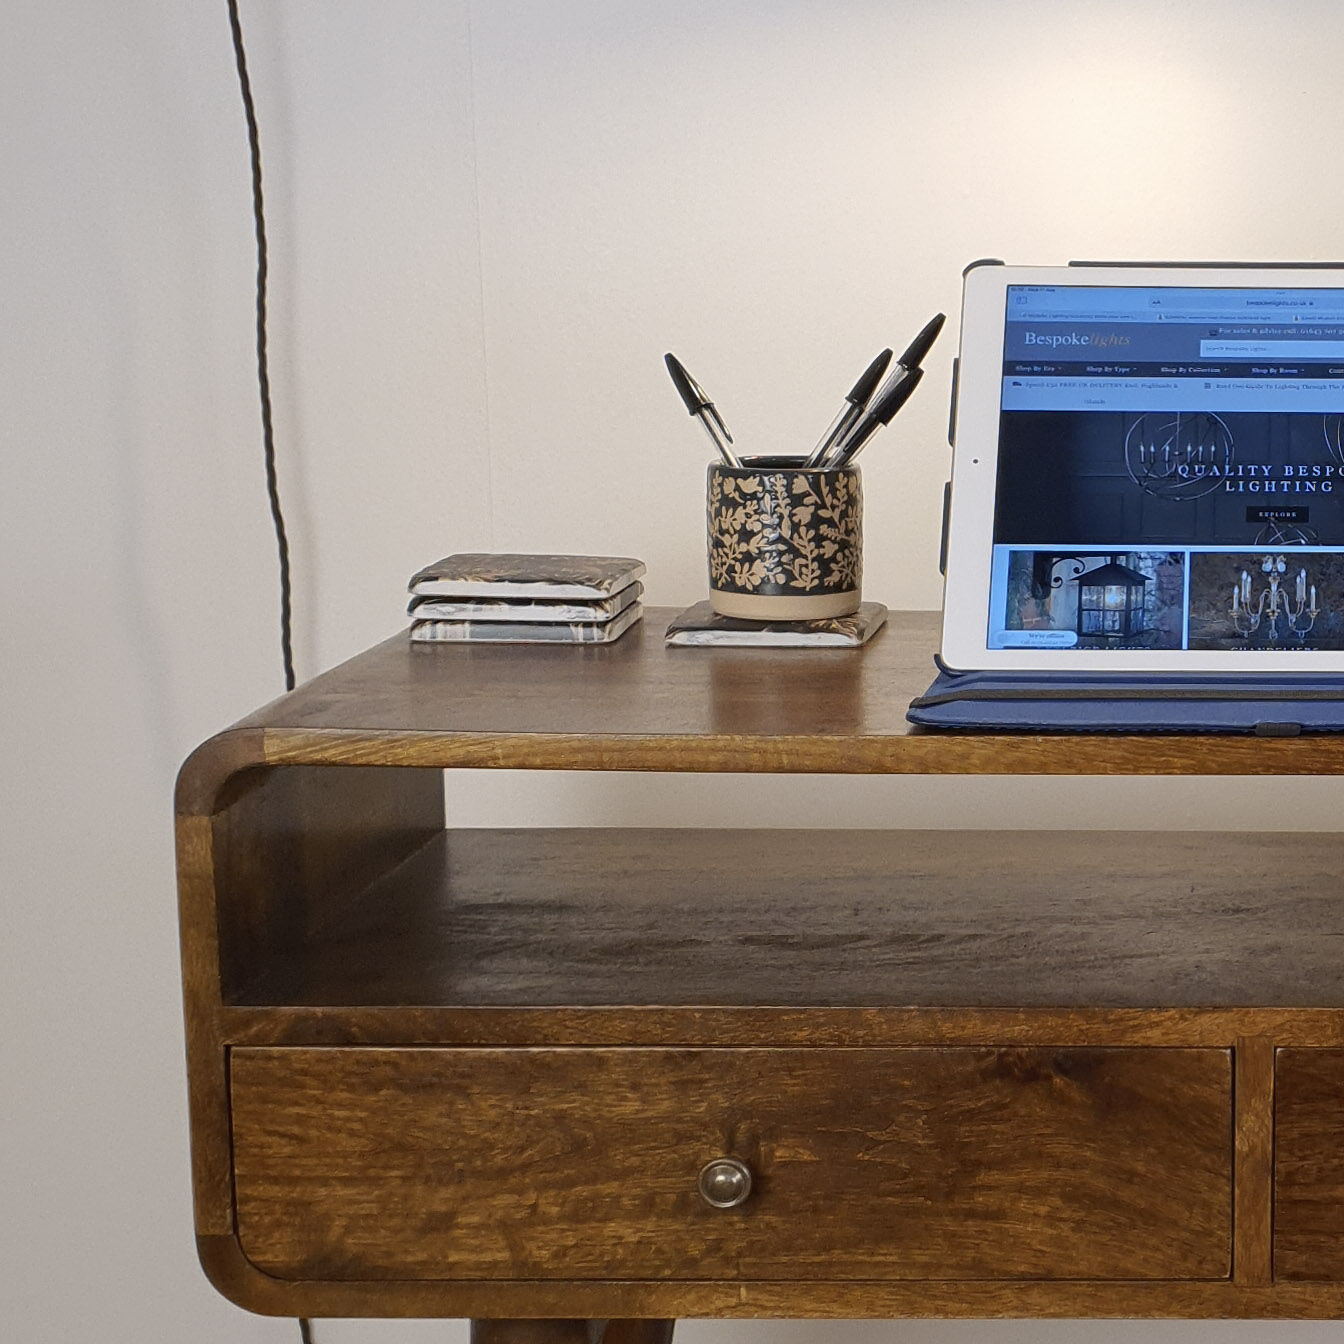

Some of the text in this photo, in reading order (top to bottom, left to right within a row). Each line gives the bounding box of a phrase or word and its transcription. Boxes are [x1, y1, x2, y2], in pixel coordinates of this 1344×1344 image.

[1114, 366, 1130, 374] Type
[1178, 465, 1273, 478] QUALITY
[1225, 481, 1333, 492] LIGHTING
